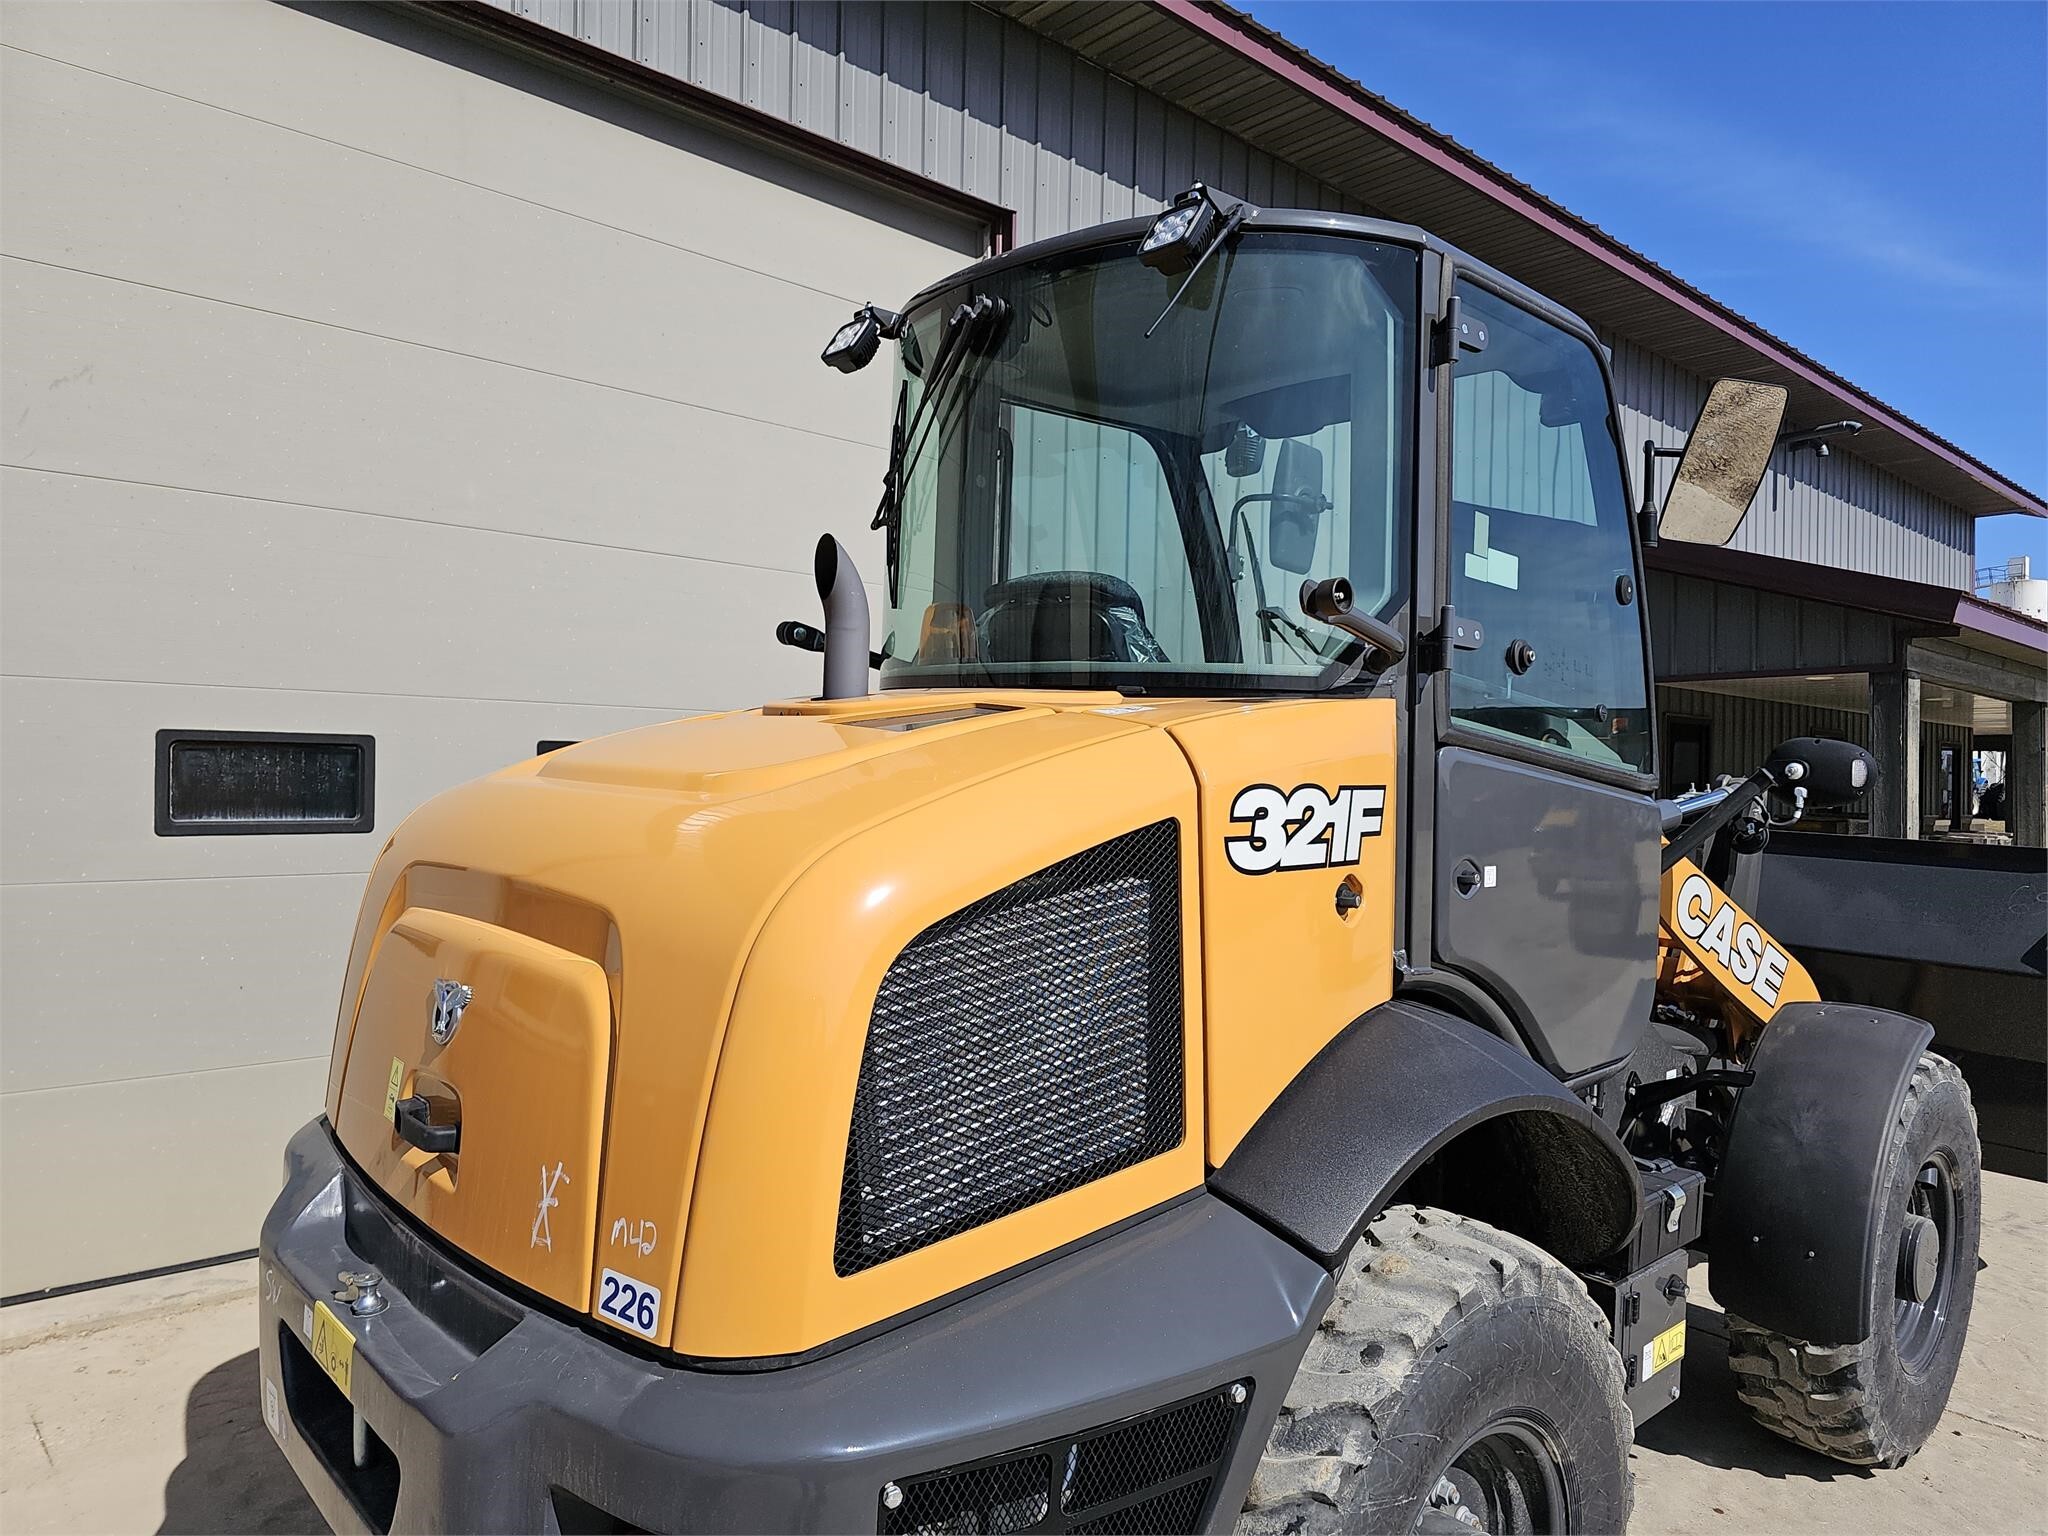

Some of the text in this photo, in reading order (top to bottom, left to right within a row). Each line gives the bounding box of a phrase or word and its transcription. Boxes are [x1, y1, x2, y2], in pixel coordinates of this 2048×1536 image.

[1225, 783, 1386, 875] 321F
[1677, 874, 1789, 1008] CASE
[600, 1276, 656, 1330] 226
